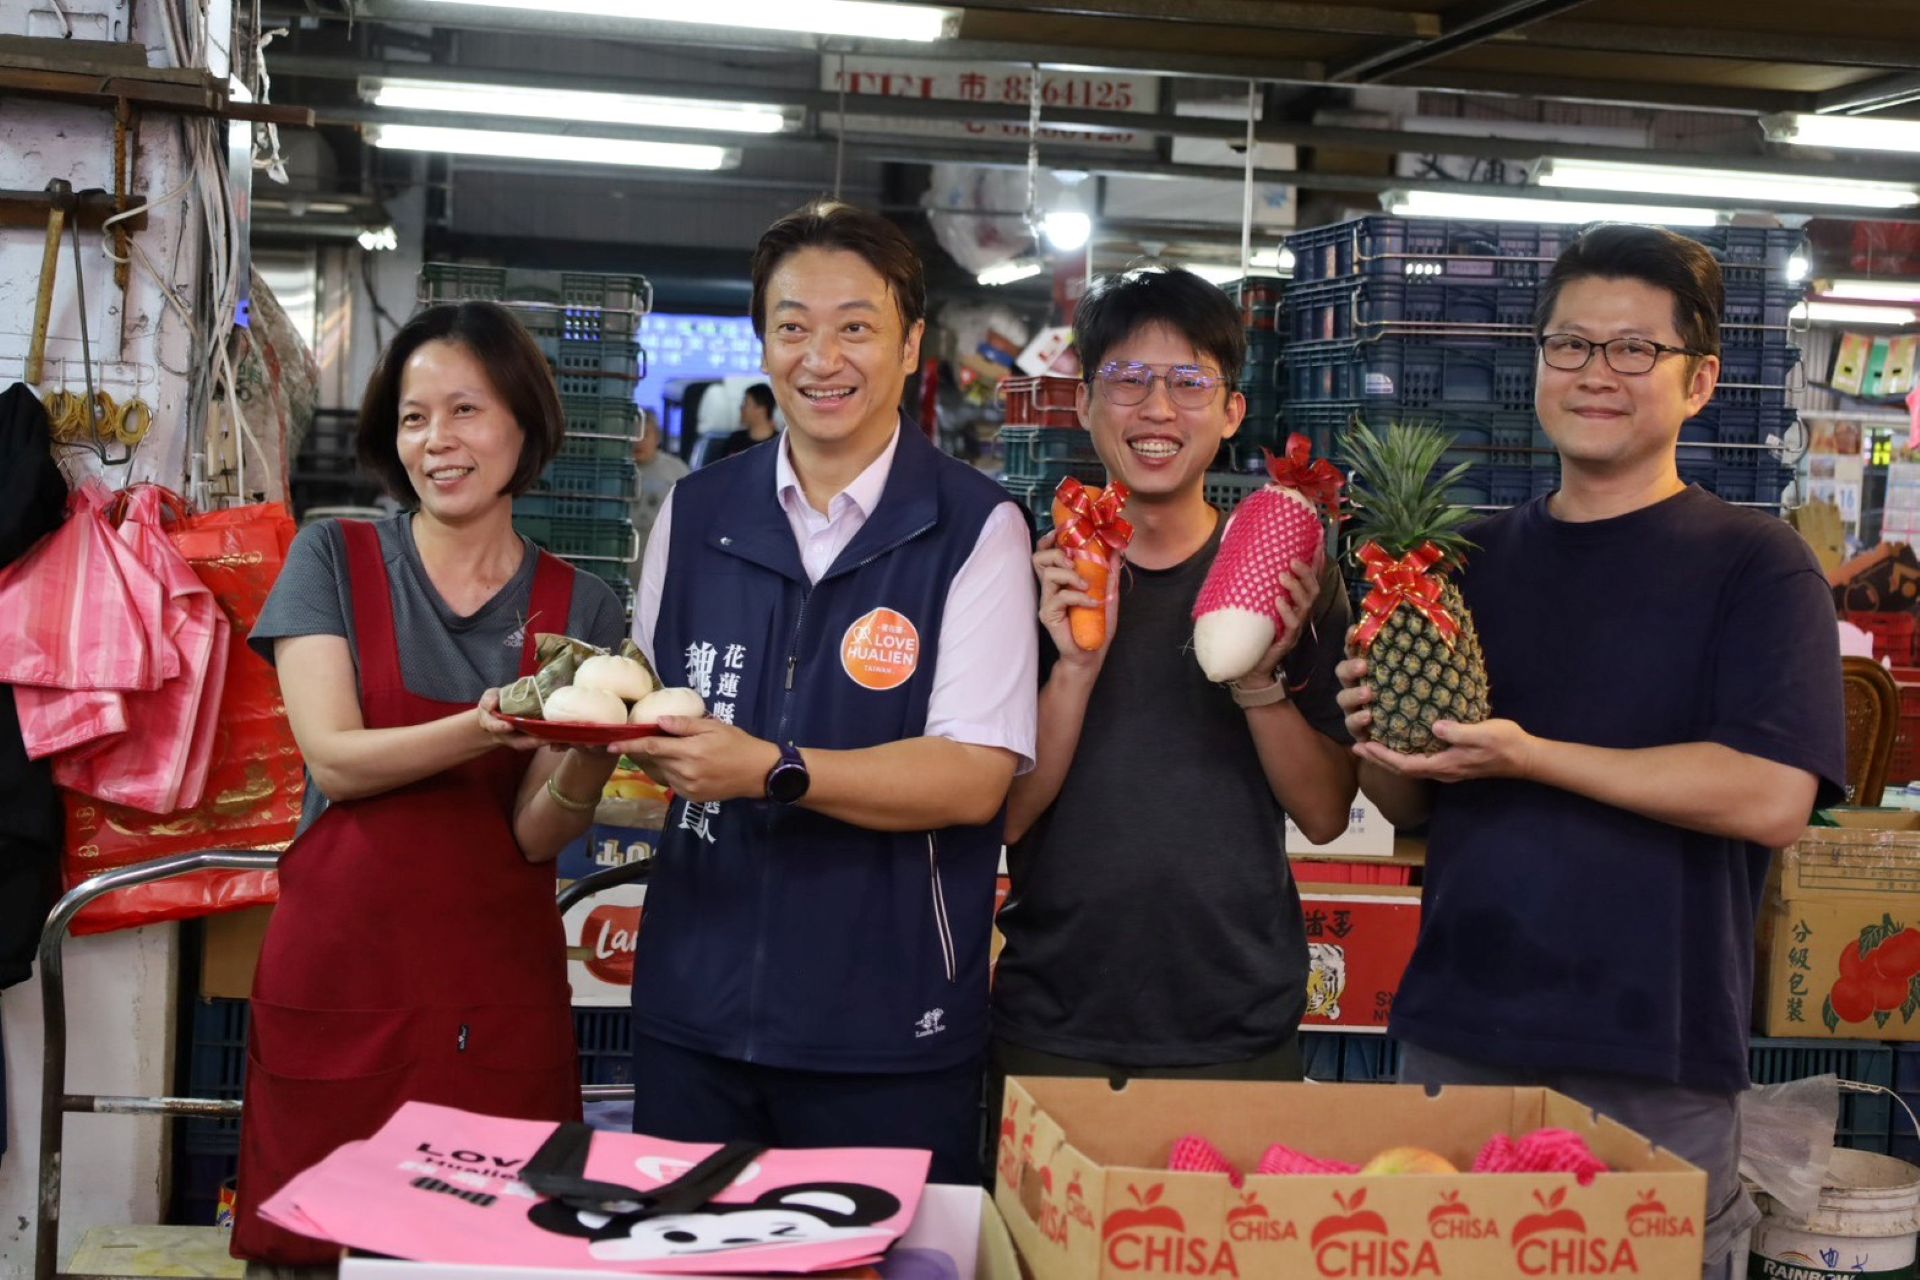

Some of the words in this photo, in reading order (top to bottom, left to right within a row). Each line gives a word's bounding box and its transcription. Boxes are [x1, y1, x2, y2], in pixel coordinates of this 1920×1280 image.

[875, 634, 915, 651] LOVE
[846, 646, 914, 667] HUALIEN
[1786, 919, 1813, 1023] 分級包裝
[416, 1142, 526, 1168] LOV
[1227, 1220, 1298, 1241] CHISA
[1430, 1218, 1500, 1239] CHISA
[1629, 1217, 1696, 1237] CHISA
[1108, 1232, 1240, 1278] CHISA
[1315, 1238, 1443, 1278] CHISA
[1516, 1238, 1640, 1276] CHISA
